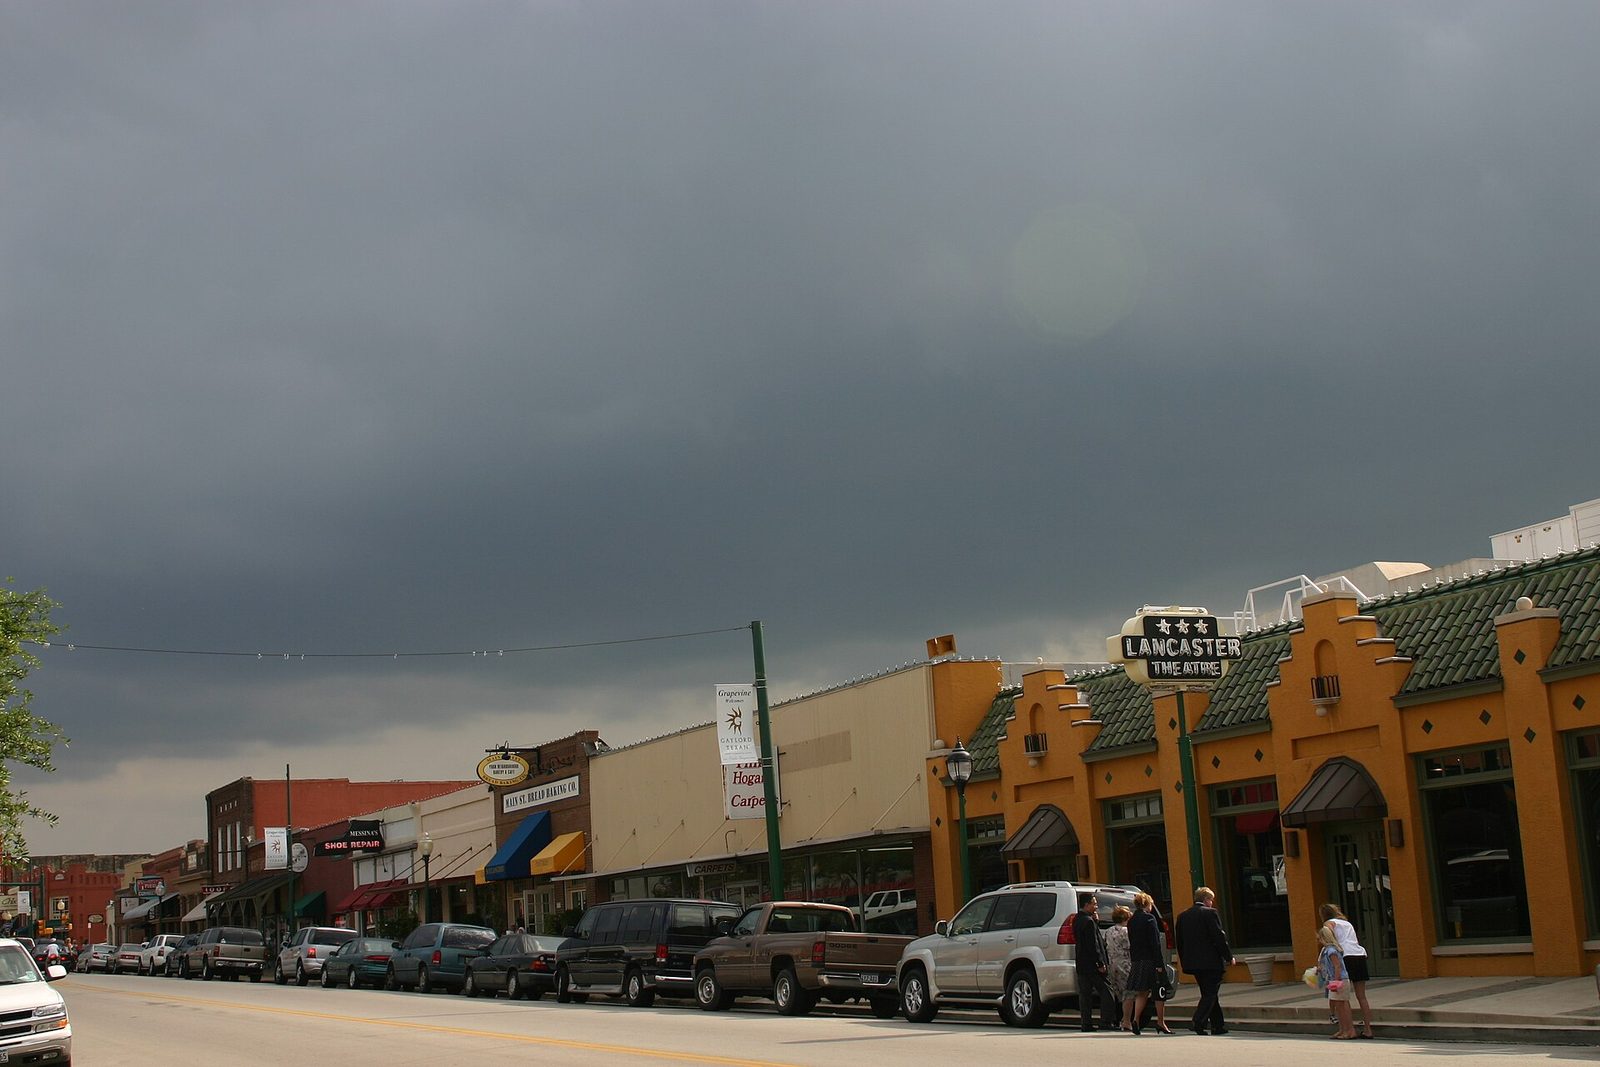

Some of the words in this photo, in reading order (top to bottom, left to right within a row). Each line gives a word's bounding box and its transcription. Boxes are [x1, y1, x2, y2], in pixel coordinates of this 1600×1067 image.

[1125, 638, 1241, 657] LANCASTER
[1151, 661, 1220, 676] THEATRE
[718, 689, 752, 698] Grapevine
[505, 796, 518, 808] MAIN
[527, 789, 546, 803] BREAD
[546, 783, 567, 798] BAKING
[568, 781, 577, 792] CO.
[324, 841, 348, 850] SHOE
[350, 840, 380, 849] REPAIR
[694, 863, 735, 874] CARPETS
